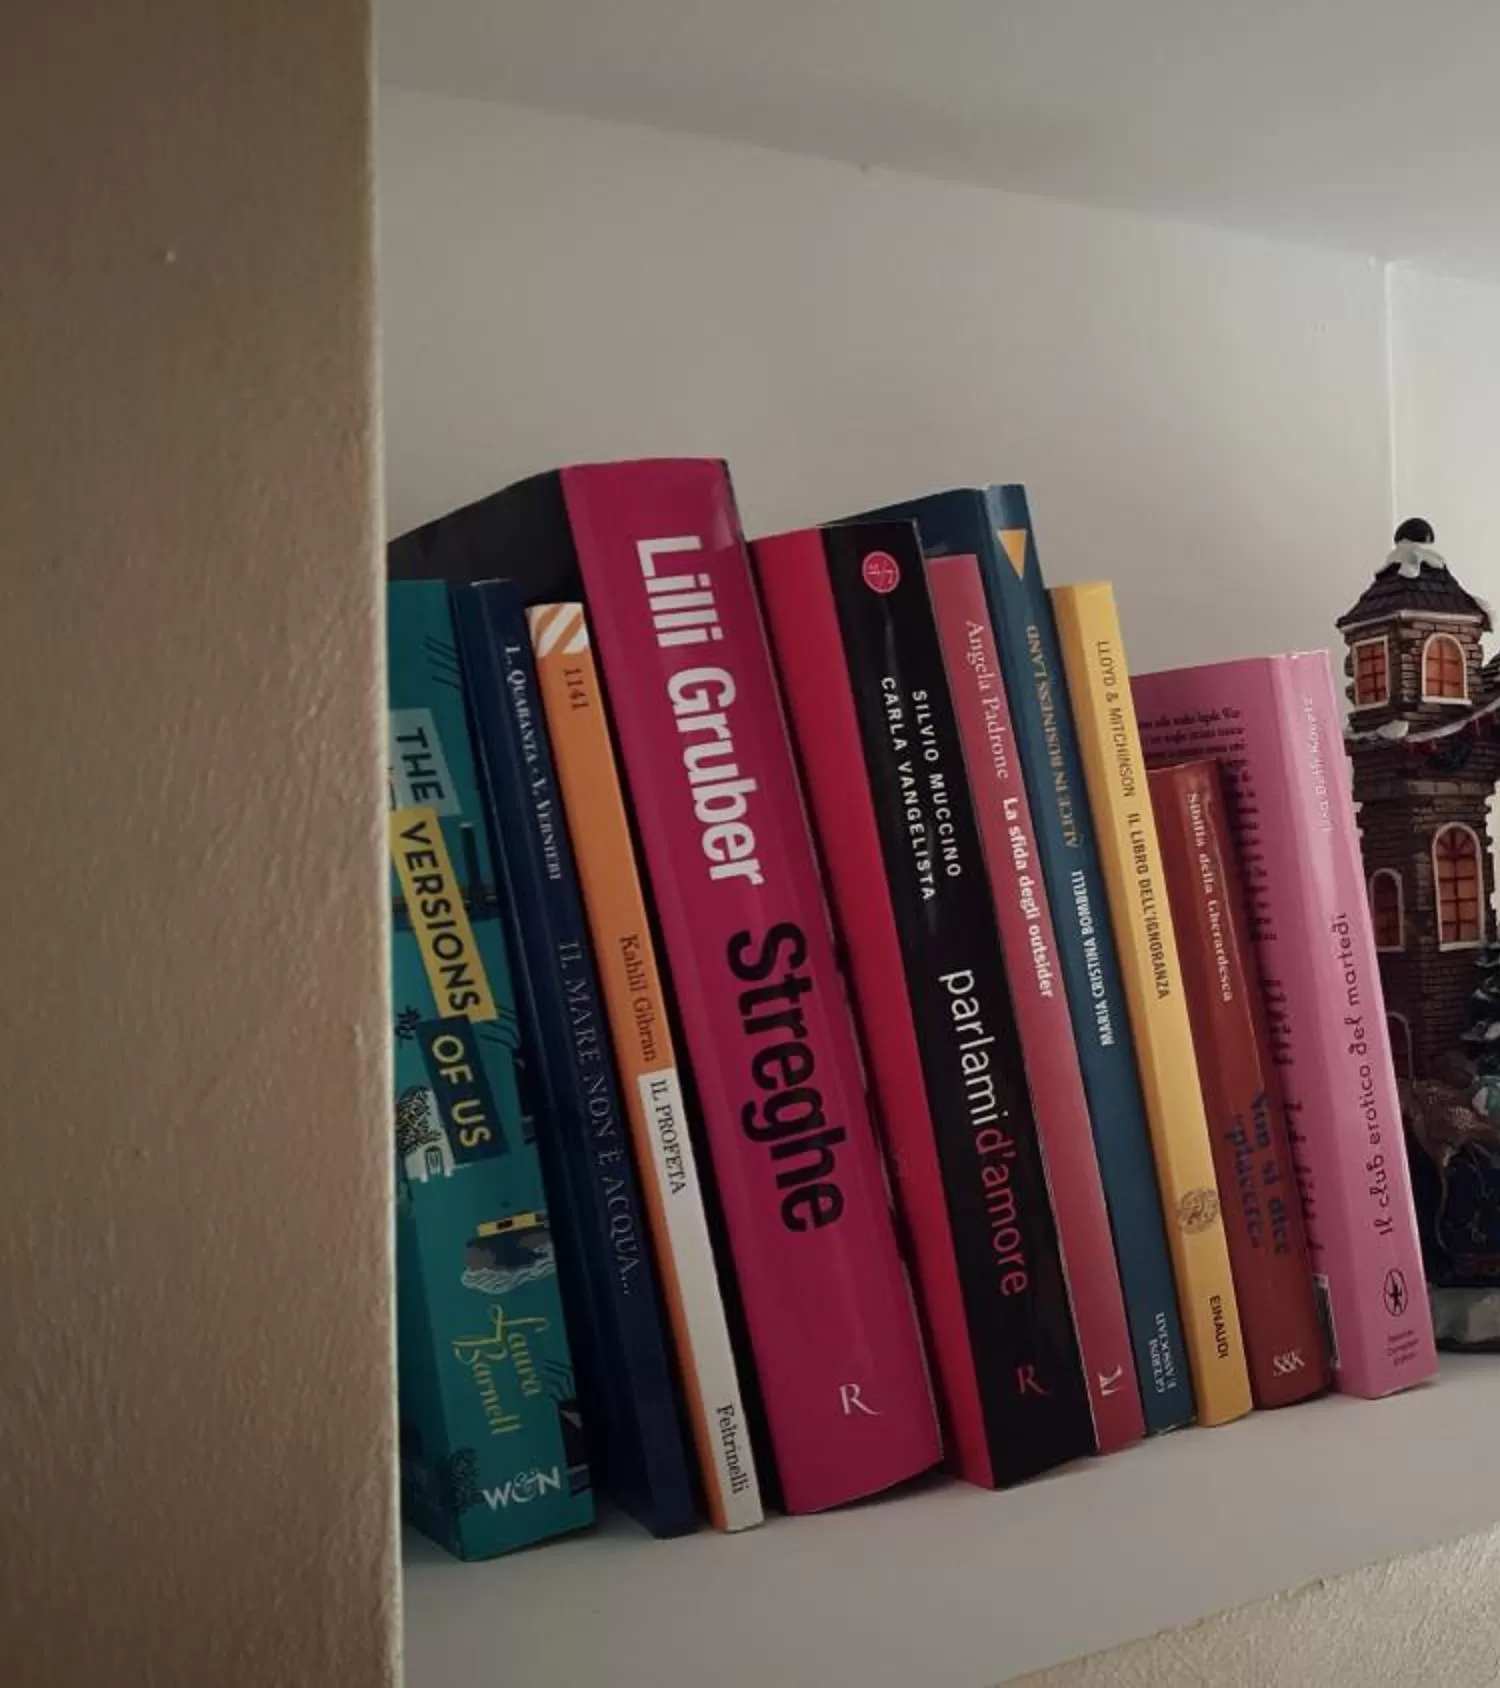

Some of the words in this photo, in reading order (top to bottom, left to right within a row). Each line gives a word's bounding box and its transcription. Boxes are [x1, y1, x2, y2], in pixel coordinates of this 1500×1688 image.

[636, 536, 723, 648] Lilli
[564, 667, 589, 710] 1141
[1098, 641, 1117, 686] LLOYD
[966, 620, 990, 691] Angela
[984, 697, 1009, 780] Padrone
[1108, 691, 1118, 702] &
[396, 728, 444, 803] THE
[667, 667, 764, 885] Gruber
[1109, 708, 1136, 797] MITCHINSON
[881, 677, 908, 750] CARLA
[897, 762, 936, 900] VANGELISTA
[913, 691, 939, 761] SILVIO
[928, 773, 962, 877] MUCCINO
[1004, 798, 1018, 820] La
[1052, 771, 1069, 795] IN
[1006, 823, 1028, 870] sfida
[1127, 812, 1140, 827] IL
[1131, 831, 1148, 875] LIBRO
[1199, 852, 1213, 892] della
[400, 822, 480, 1011] VERSIONS
[1017, 877, 1040, 920] degli
[1071, 870, 1097, 936] BOMBELLI
[558, 939, 580, 969] IL
[619, 933, 648, 993] Kahlil
[1028, 924, 1053, 998] outsider
[1082, 936, 1107, 996] CRISTINA
[1137, 877, 1170, 999] DELL'IGNORANZA
[564, 980, 600, 1064] MARE
[633, 998, 657, 1062] Gibran
[939, 969, 1008, 1125] parlami
[1095, 996, 1116, 1047] MARIA
[1345, 1016, 1367, 1056] del
[432, 1035, 473, 1084] OF
[727, 922, 847, 1232] Streghe
[583, 1073, 612, 1138] NON
[650, 1080, 668, 1101] IL
[1359, 1064, 1382, 1145] erotico
[452, 1100, 490, 1148] US
[654, 1105, 687, 1194] PROFETA
[1367, 1156, 1389, 1207] club
[1375, 1212, 1392, 1235] Il
[491, 1304, 549, 1398] Laura
[1209, 1295, 1229, 1358] EINAUDI
[839, 1383, 881, 1415] R
[1018, 1364, 1049, 1394] R
[716, 1403, 750, 1495] Feltrinelli
[482, 1467, 561, 1511] W&N
